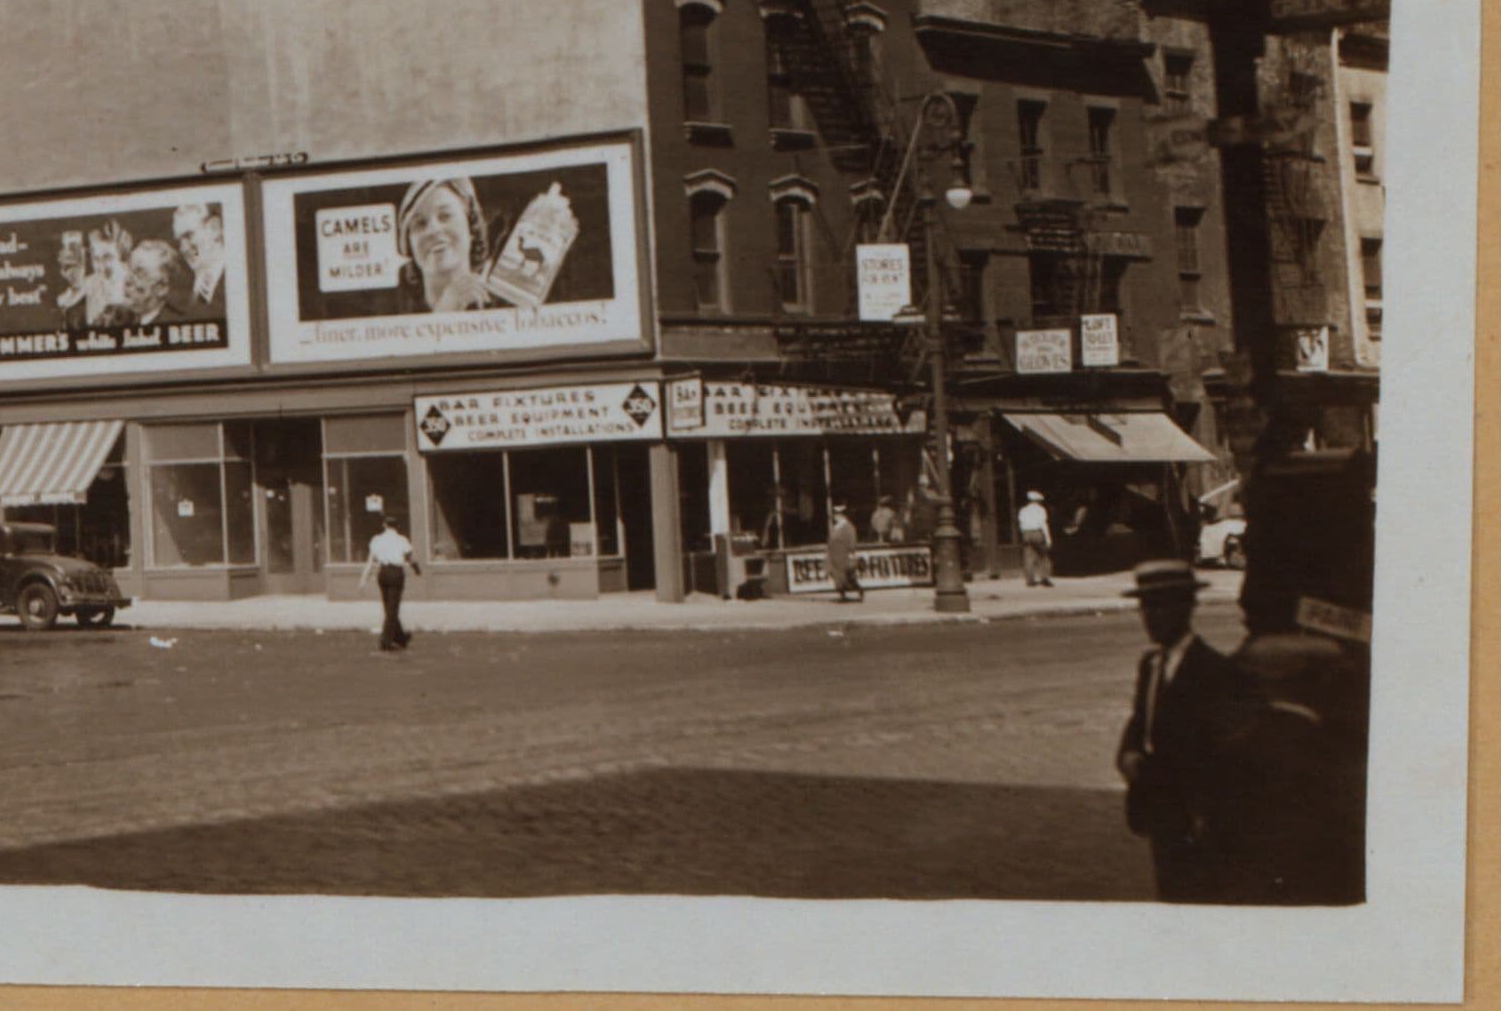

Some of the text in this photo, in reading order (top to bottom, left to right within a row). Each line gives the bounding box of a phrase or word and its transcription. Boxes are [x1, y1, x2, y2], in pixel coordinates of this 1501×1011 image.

[321, 214, 392, 238] CAMELS
[343, 241, 370, 255] ARE
[168, 323, 220, 344] BEER
[365, 324, 411, 342] more
[415, 316, 506, 342] expensive
[440, 391, 597, 411] BAR FIXTURES
[455, 407, 610, 426] BEER EQUIPMENT
[467, 422, 635, 442] COMPLETE INSTALLATIONS
